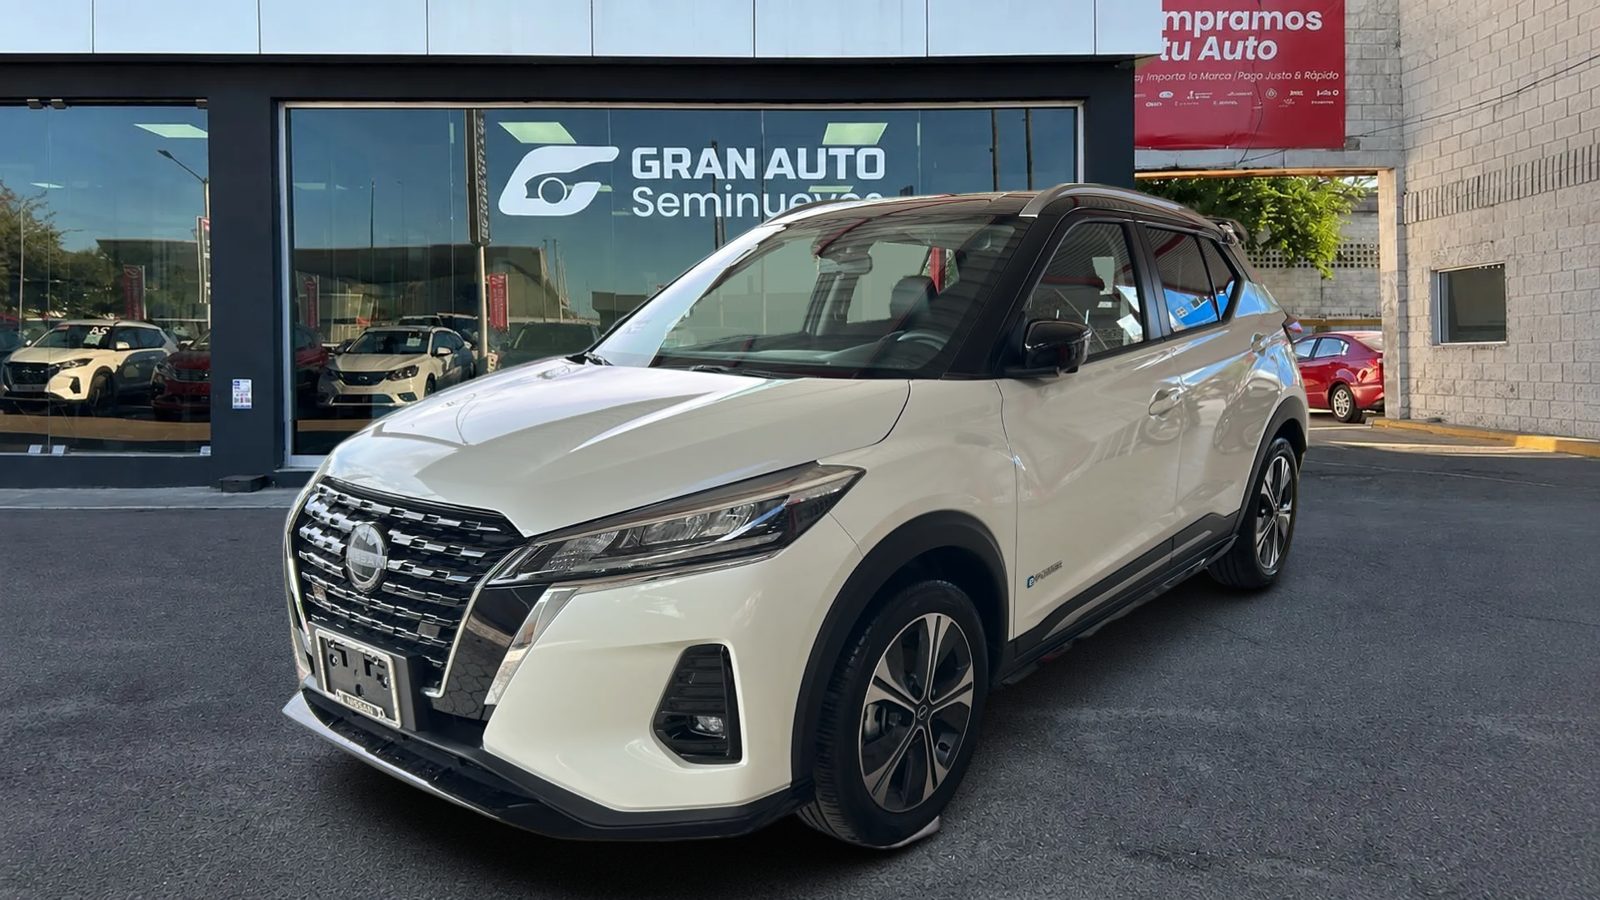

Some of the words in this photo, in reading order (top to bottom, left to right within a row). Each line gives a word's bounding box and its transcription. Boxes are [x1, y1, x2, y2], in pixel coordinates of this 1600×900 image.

[1159, 36, 1191, 61] tu
[1197, 36, 1278, 61] Auto
[1146, 72, 1186, 83] Importa
[1188, 71, 1198, 81] la
[1199, 71, 1232, 81] Marca
[1294, 70, 1301, 80] &
[632, 147, 755, 180] GRAN
[763, 147, 886, 180] AUTO
[346, 696, 374, 714] NISSAN
